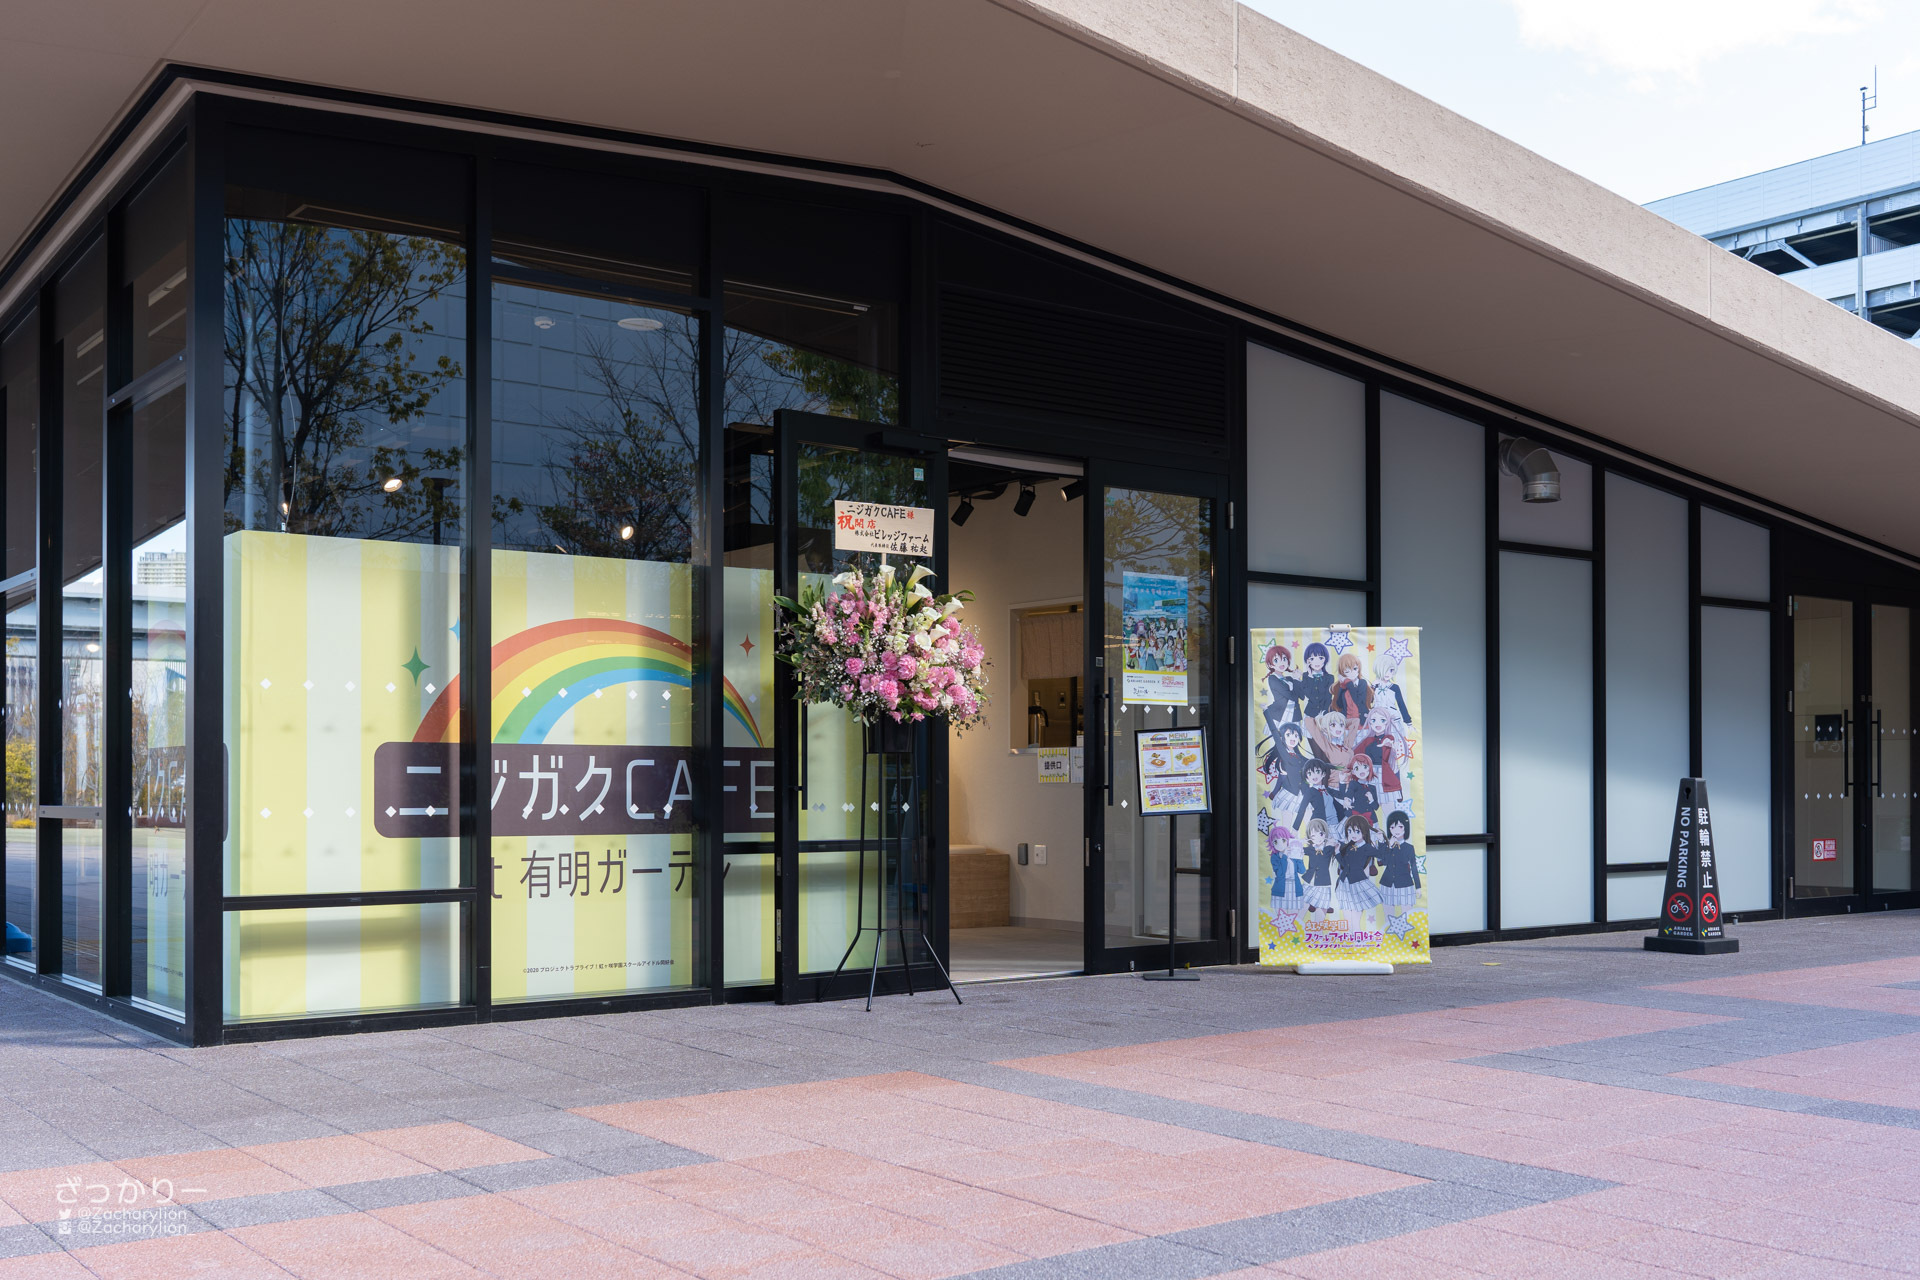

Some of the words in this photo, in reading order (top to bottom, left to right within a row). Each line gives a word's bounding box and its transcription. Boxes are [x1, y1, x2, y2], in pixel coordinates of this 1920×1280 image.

[1680, 807, 1691, 827] NO
[1676, 831, 1690, 888] PARKING
[1698, 807, 1713, 888] 駐輪禁止
